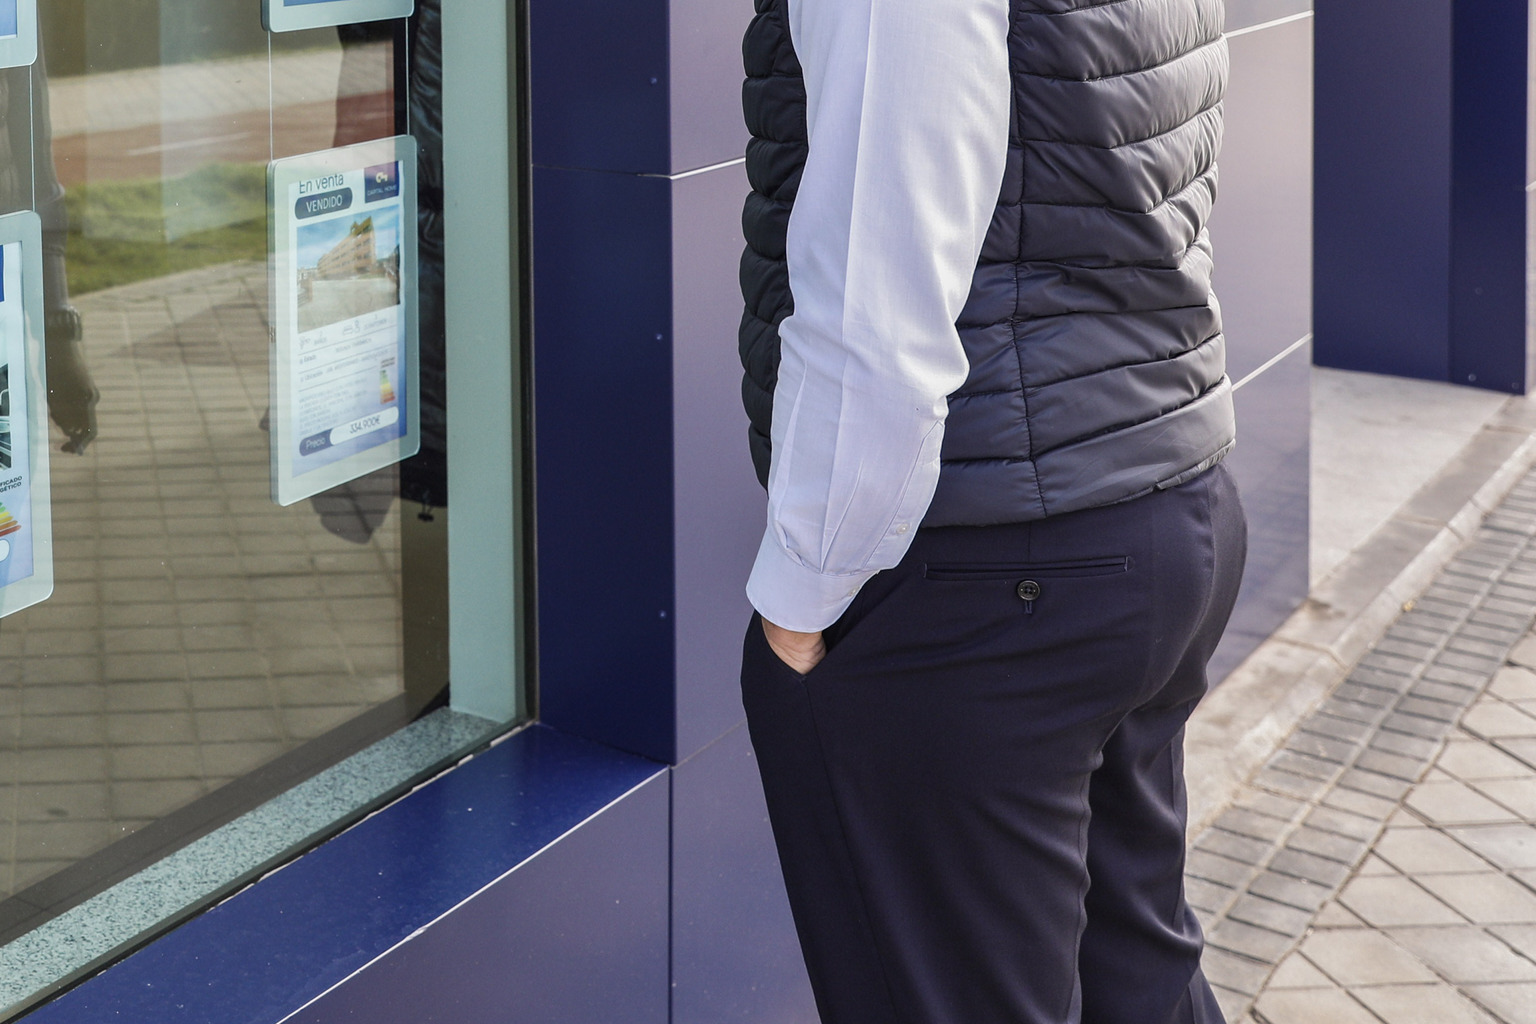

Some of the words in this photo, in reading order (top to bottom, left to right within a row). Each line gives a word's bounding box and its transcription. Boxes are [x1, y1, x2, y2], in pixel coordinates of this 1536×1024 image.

[299, 180, 312, 194] En
[315, 174, 344, 189] venta
[306, 194, 343, 213] VENDIDO
